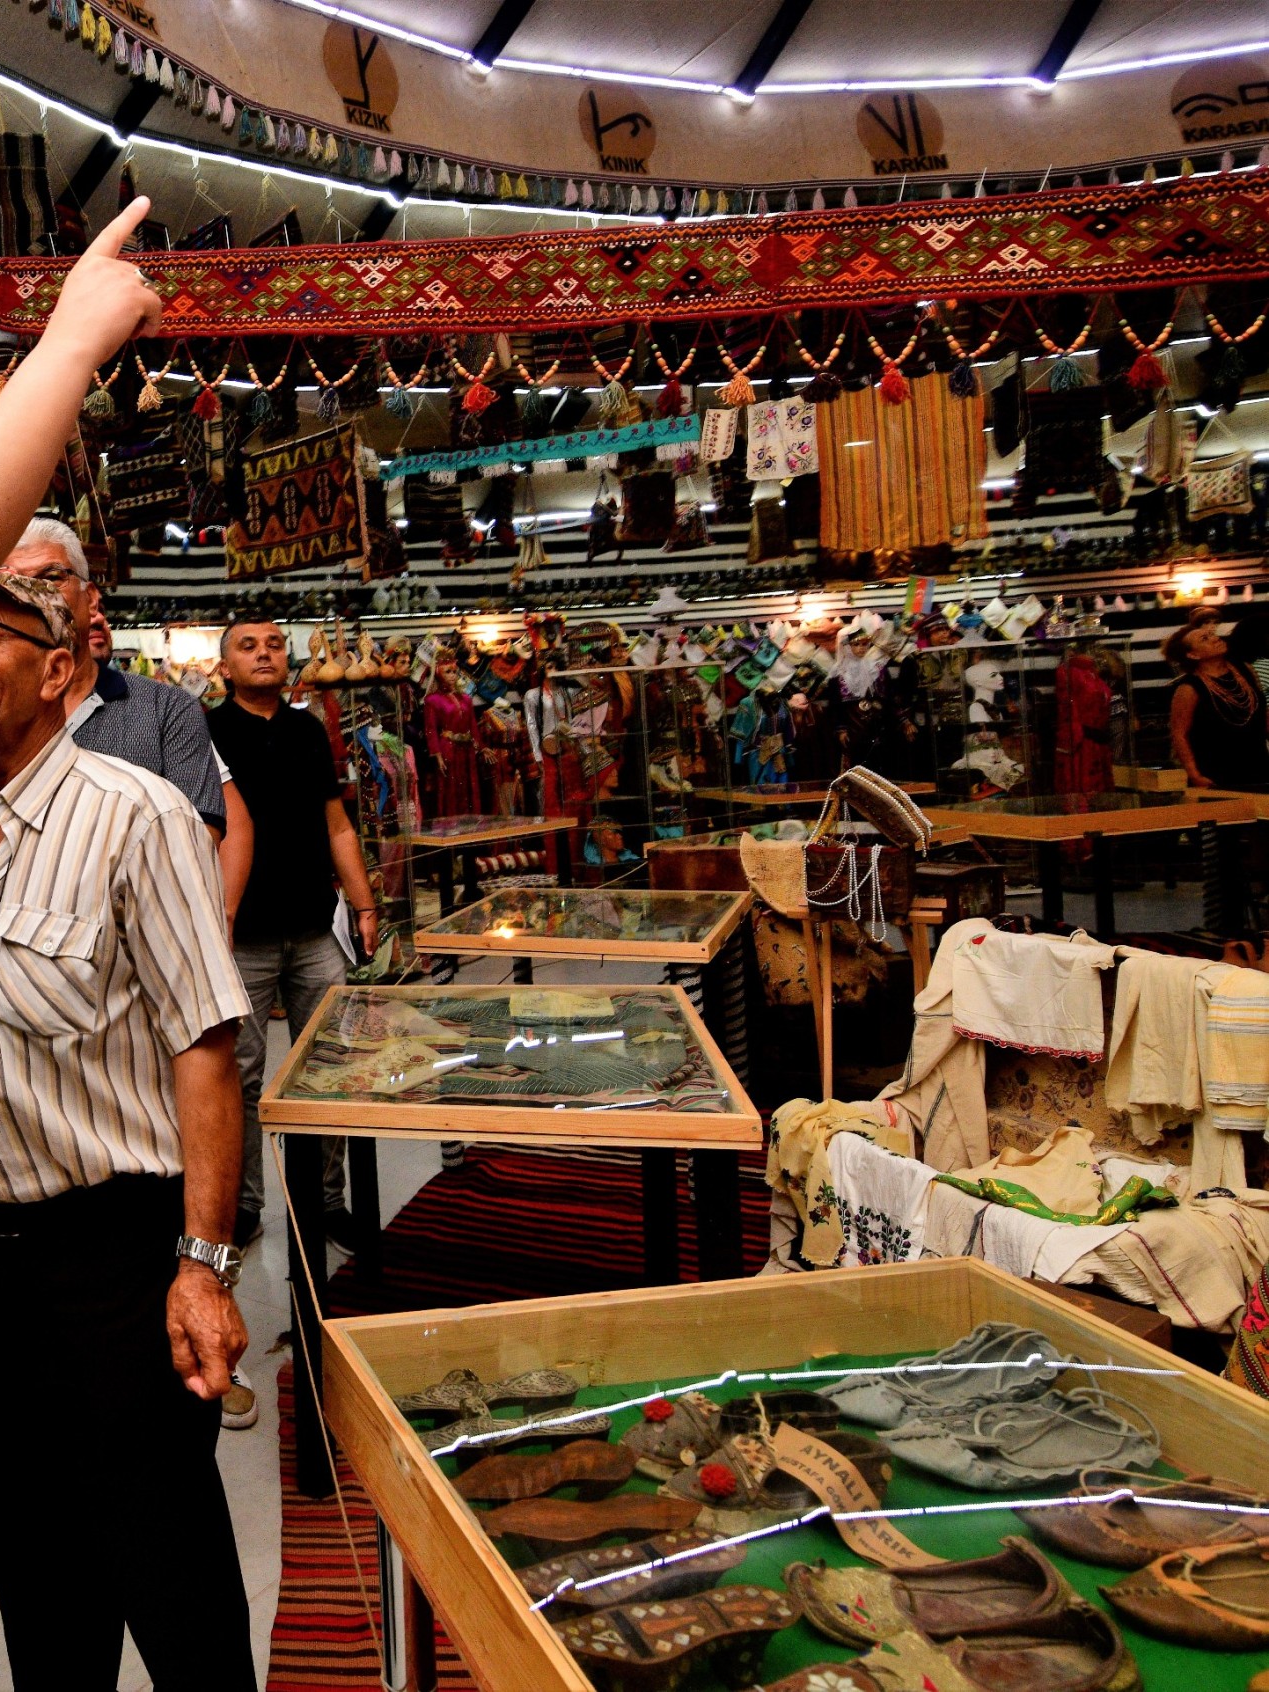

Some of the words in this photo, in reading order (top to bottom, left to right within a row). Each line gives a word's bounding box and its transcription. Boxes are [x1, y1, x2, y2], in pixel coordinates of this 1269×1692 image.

[346, 105, 391, 132] KIZIK
[600, 155, 648, 174] KINIK
[873, 154, 949, 175] KARKIN
[800, 1445, 864, 1501] AYNALI
